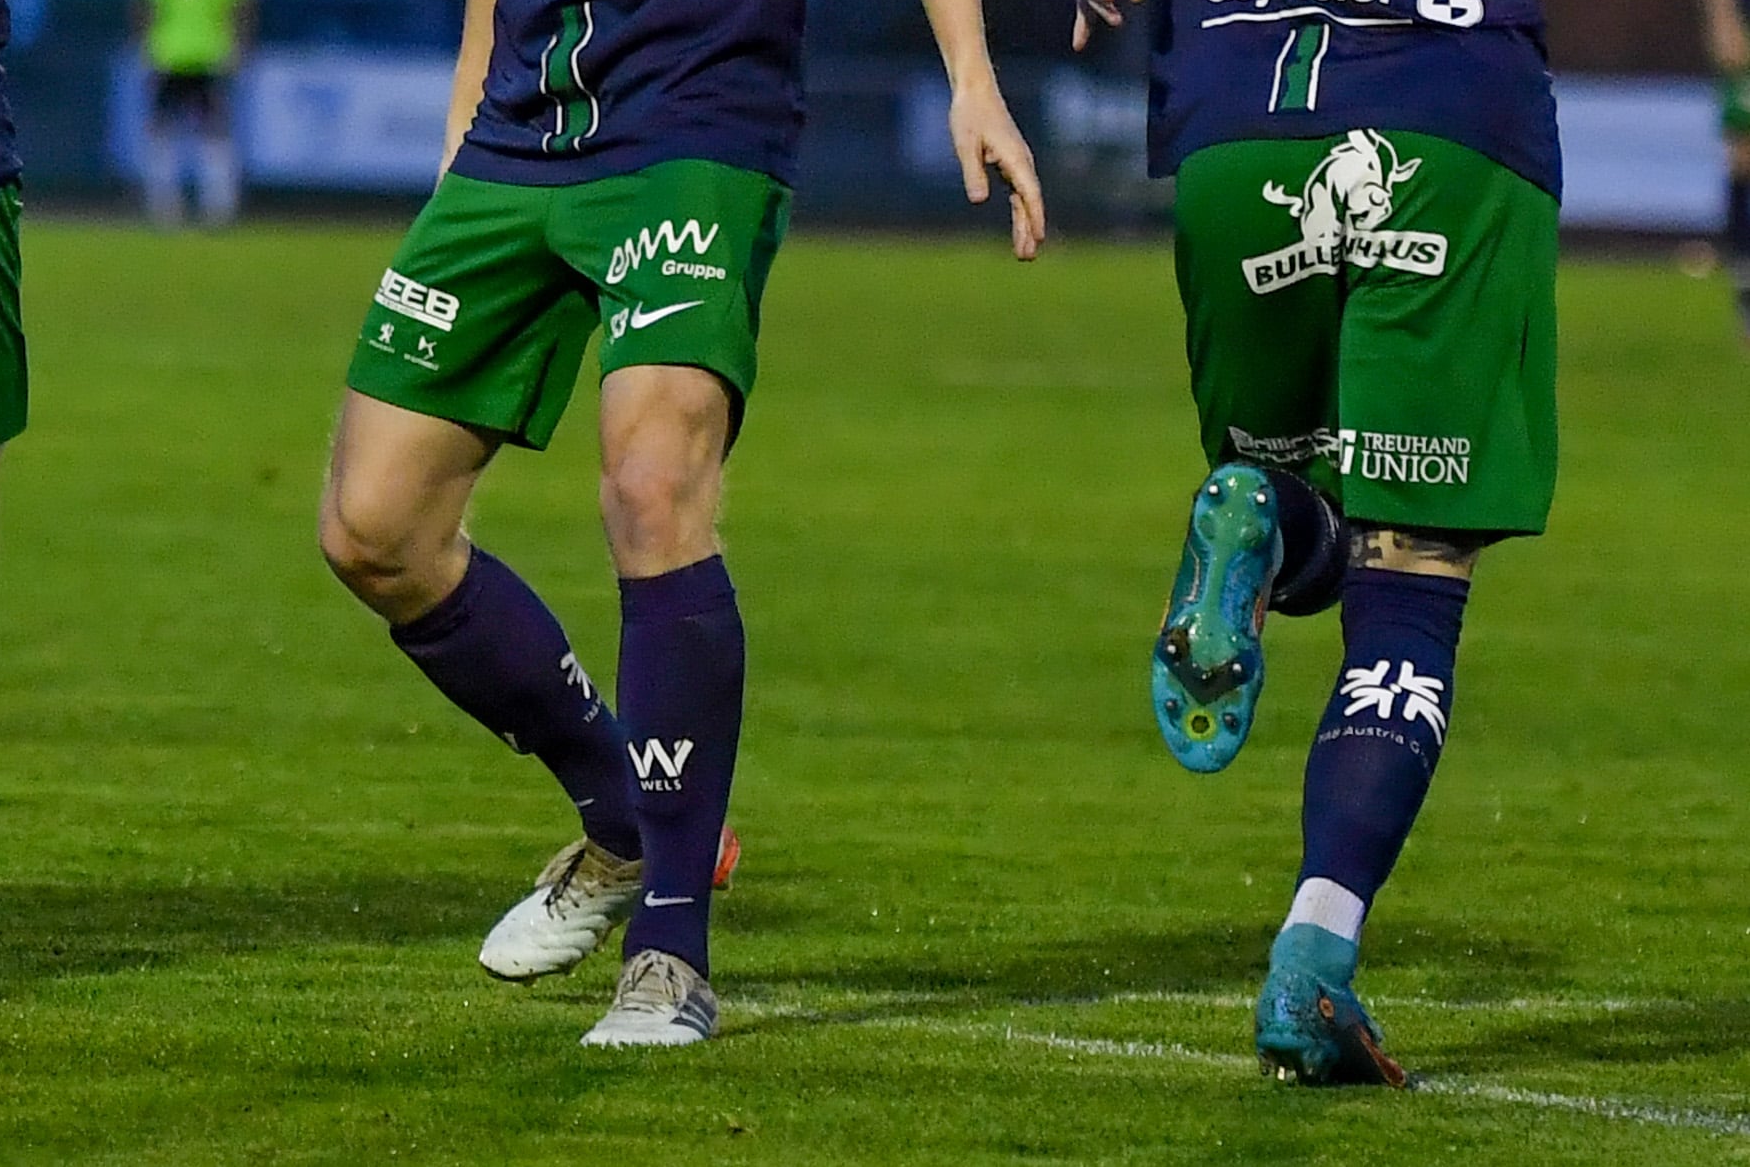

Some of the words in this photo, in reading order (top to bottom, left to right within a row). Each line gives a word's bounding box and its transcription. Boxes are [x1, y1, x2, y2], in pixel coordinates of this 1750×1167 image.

[661, 259, 727, 280] Gruppe
[1361, 432, 1470, 455] TREUHAND
[1361, 450, 1470, 484] UNION
[640, 780, 682, 792] WELS
